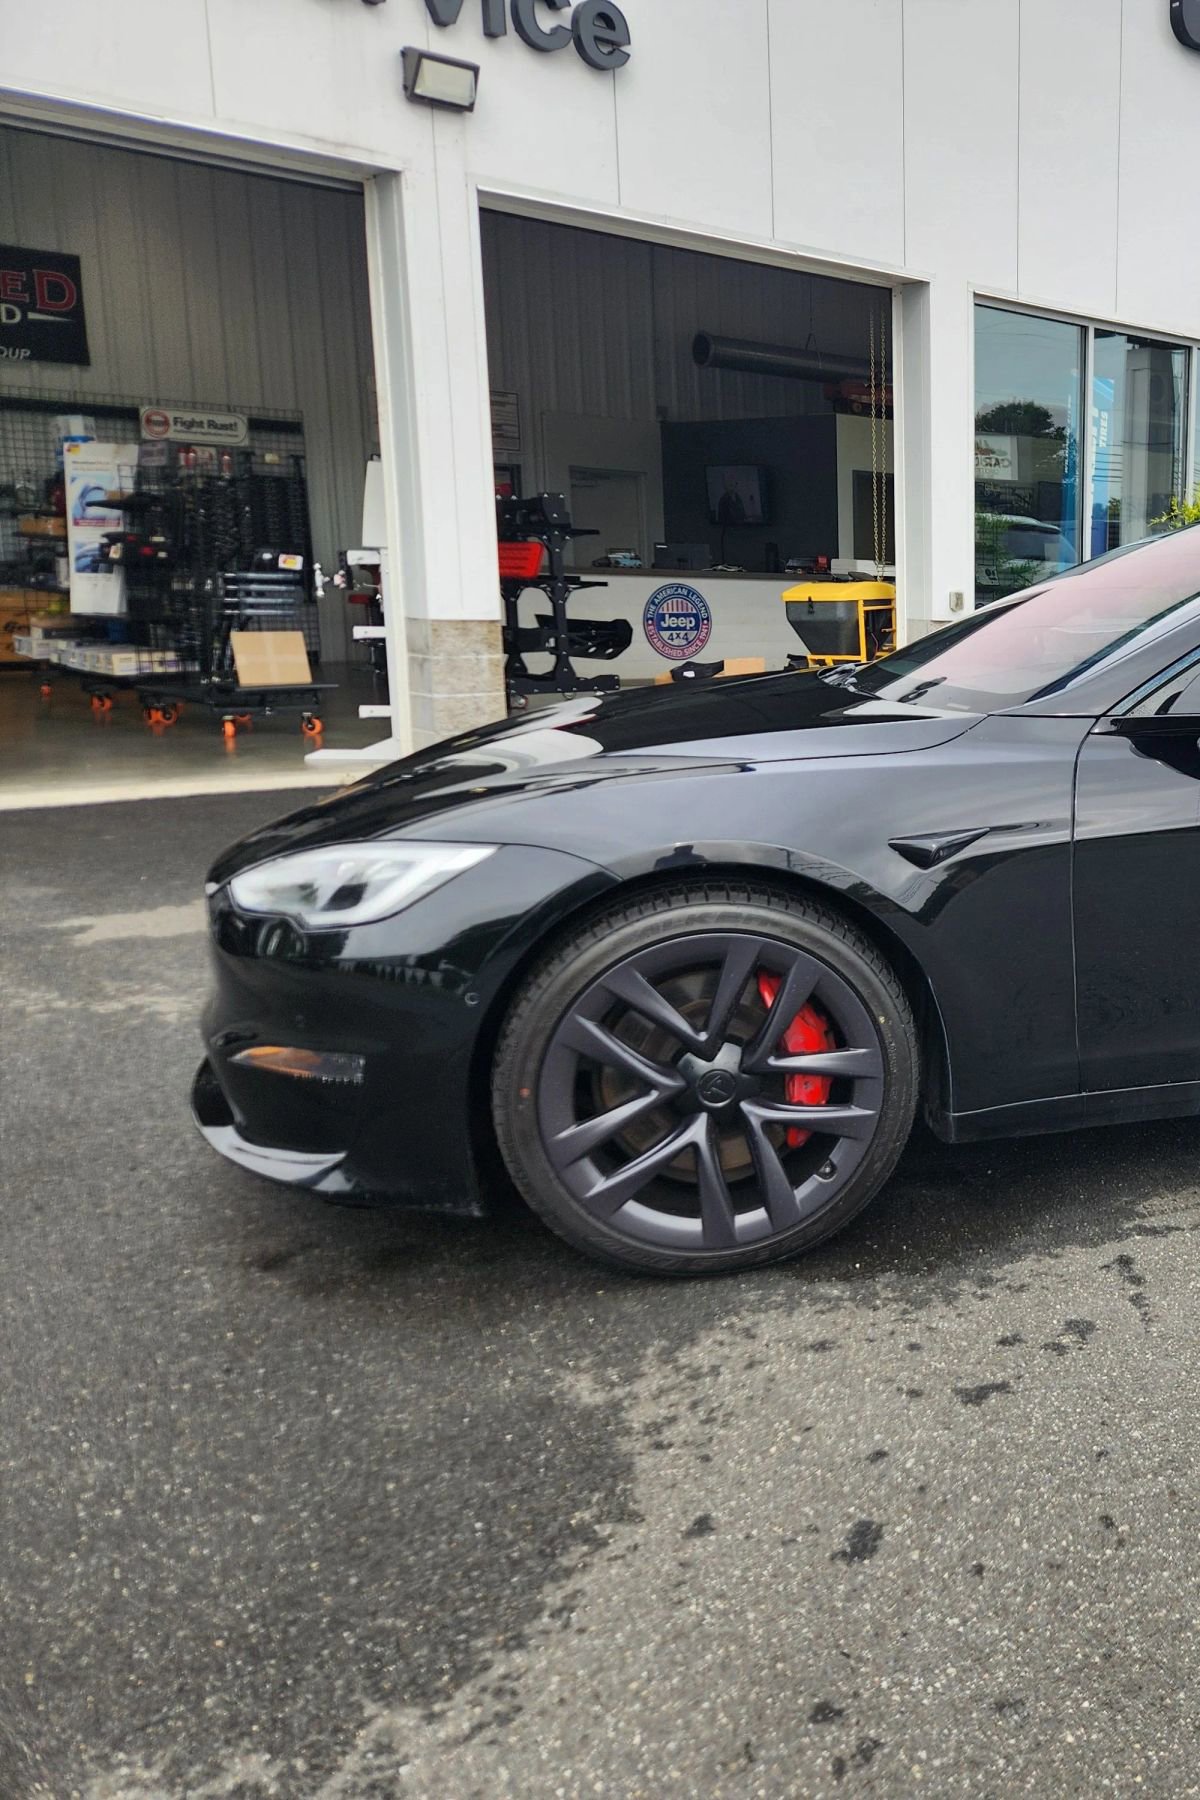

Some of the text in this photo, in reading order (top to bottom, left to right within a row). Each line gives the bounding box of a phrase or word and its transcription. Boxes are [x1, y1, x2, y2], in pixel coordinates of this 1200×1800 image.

[173, 416, 205, 430] Fight
[206, 418, 238, 431] Rust!
[647, 587, 708, 619] THE AMERICAN LEGEND
[660, 614, 696, 630] Jeep
[647, 625, 683, 657] ESTABLISHED
[683, 639, 702, 656] SINCE
